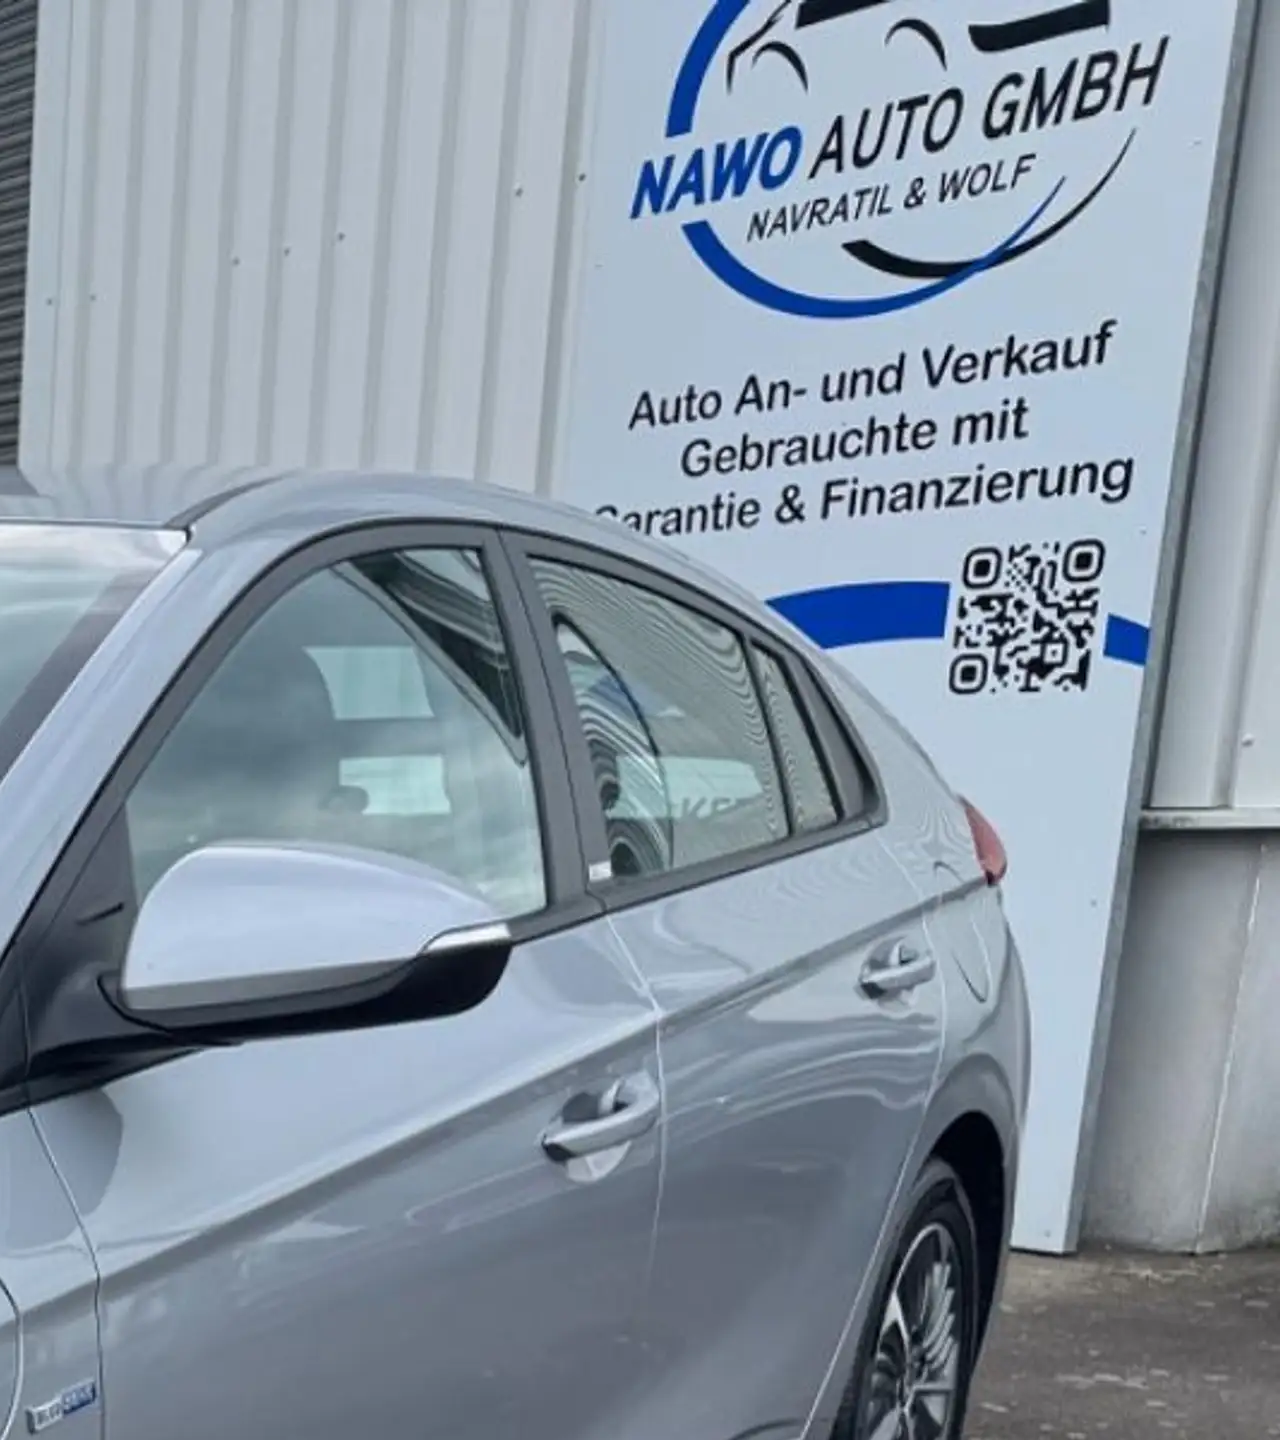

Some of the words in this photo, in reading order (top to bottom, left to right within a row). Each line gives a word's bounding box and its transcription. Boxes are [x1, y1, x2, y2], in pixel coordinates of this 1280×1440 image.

[630, 125, 803, 219] NAWO
[808, 87, 964, 179] AUTO
[982, 35, 1170, 139] GMBH
[746, 183, 893, 242] NAVRATIL
[903, 177, 927, 209] &
[938, 153, 1037, 202] WOLF
[628, 384, 722, 430] Auto
[734, 374, 807, 415] An-
[821, 351, 906, 402] und
[922, 319, 1118, 389] Verkauf
[680, 412, 937, 478] Gebrauchte
[952, 397, 1029, 446] mit
[596, 491, 761, 536] arantie
[775, 483, 806, 525] &
[820, 457, 1134, 520] Finanzierung
